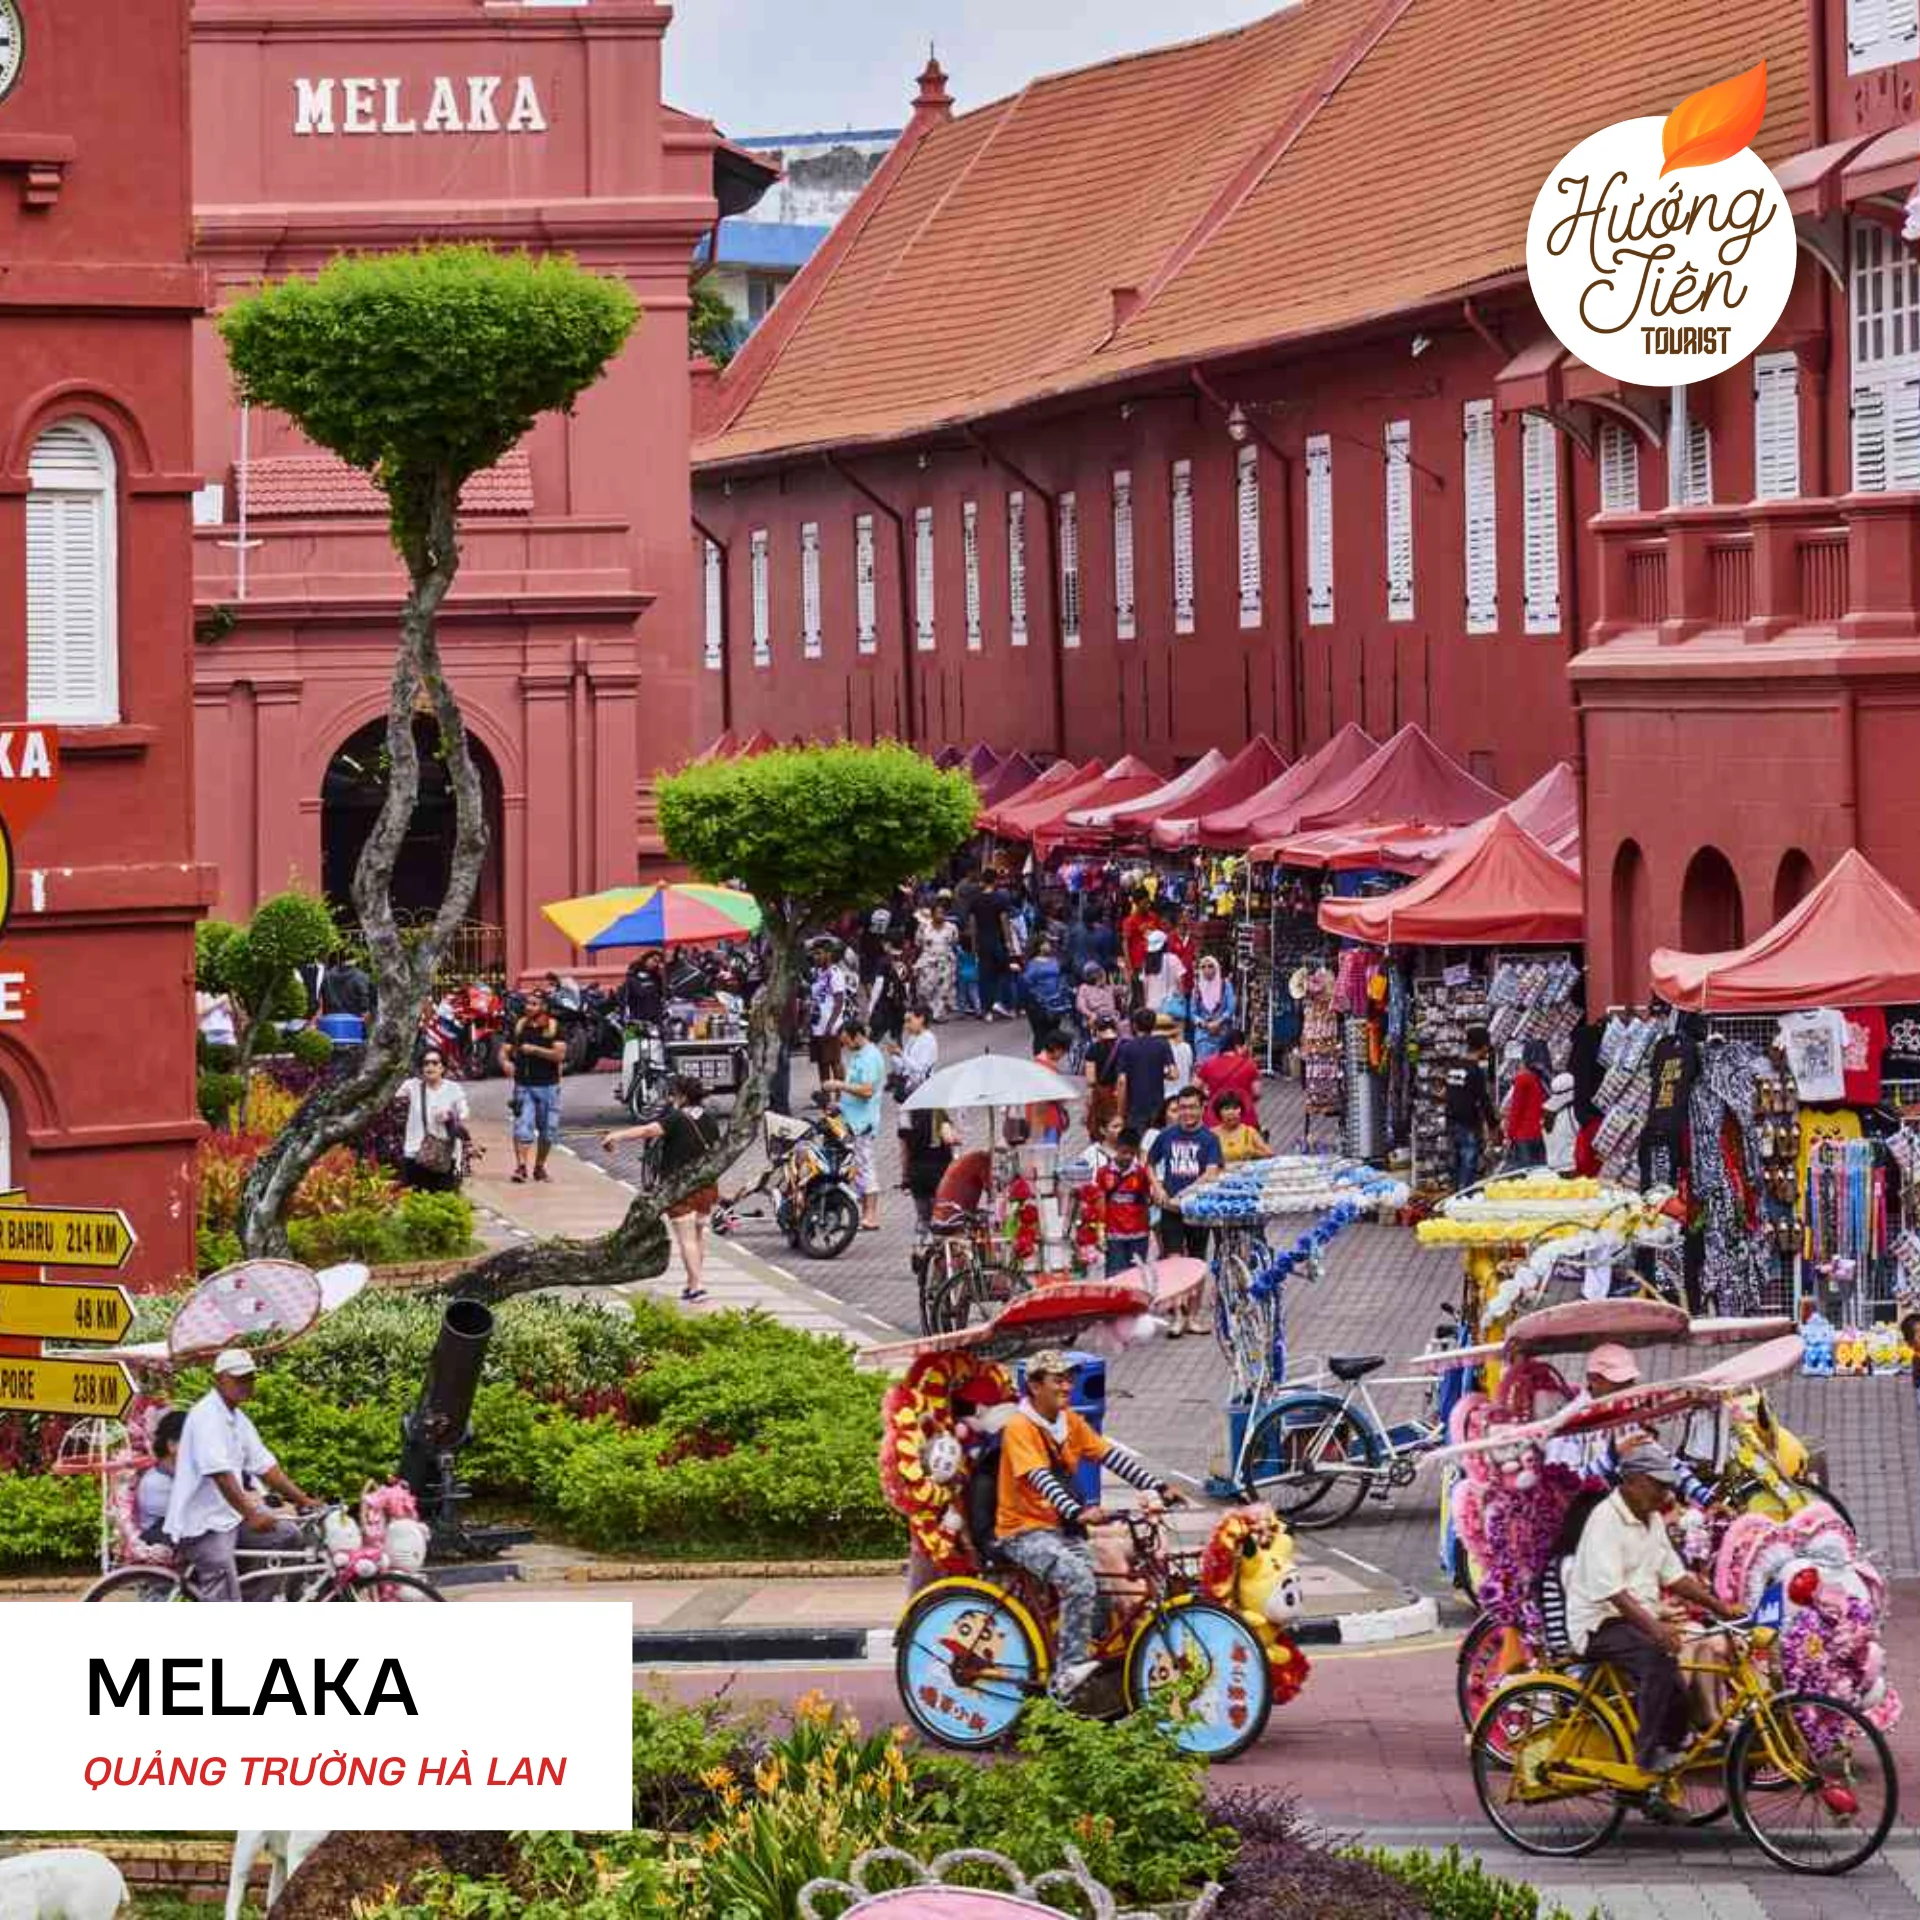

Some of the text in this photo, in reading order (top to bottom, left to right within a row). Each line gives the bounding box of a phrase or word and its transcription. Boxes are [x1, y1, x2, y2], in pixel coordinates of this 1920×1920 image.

[294, 75, 548, 134] MELAKA
[9, 1219, 54, 1252] BAHRU
[66, 1222, 91, 1253] 214
[96, 1223, 118, 1254] KM
[75, 1298, 118, 1329] 48 KM
[0, 1368, 118, 1405] PORE 238 KM
